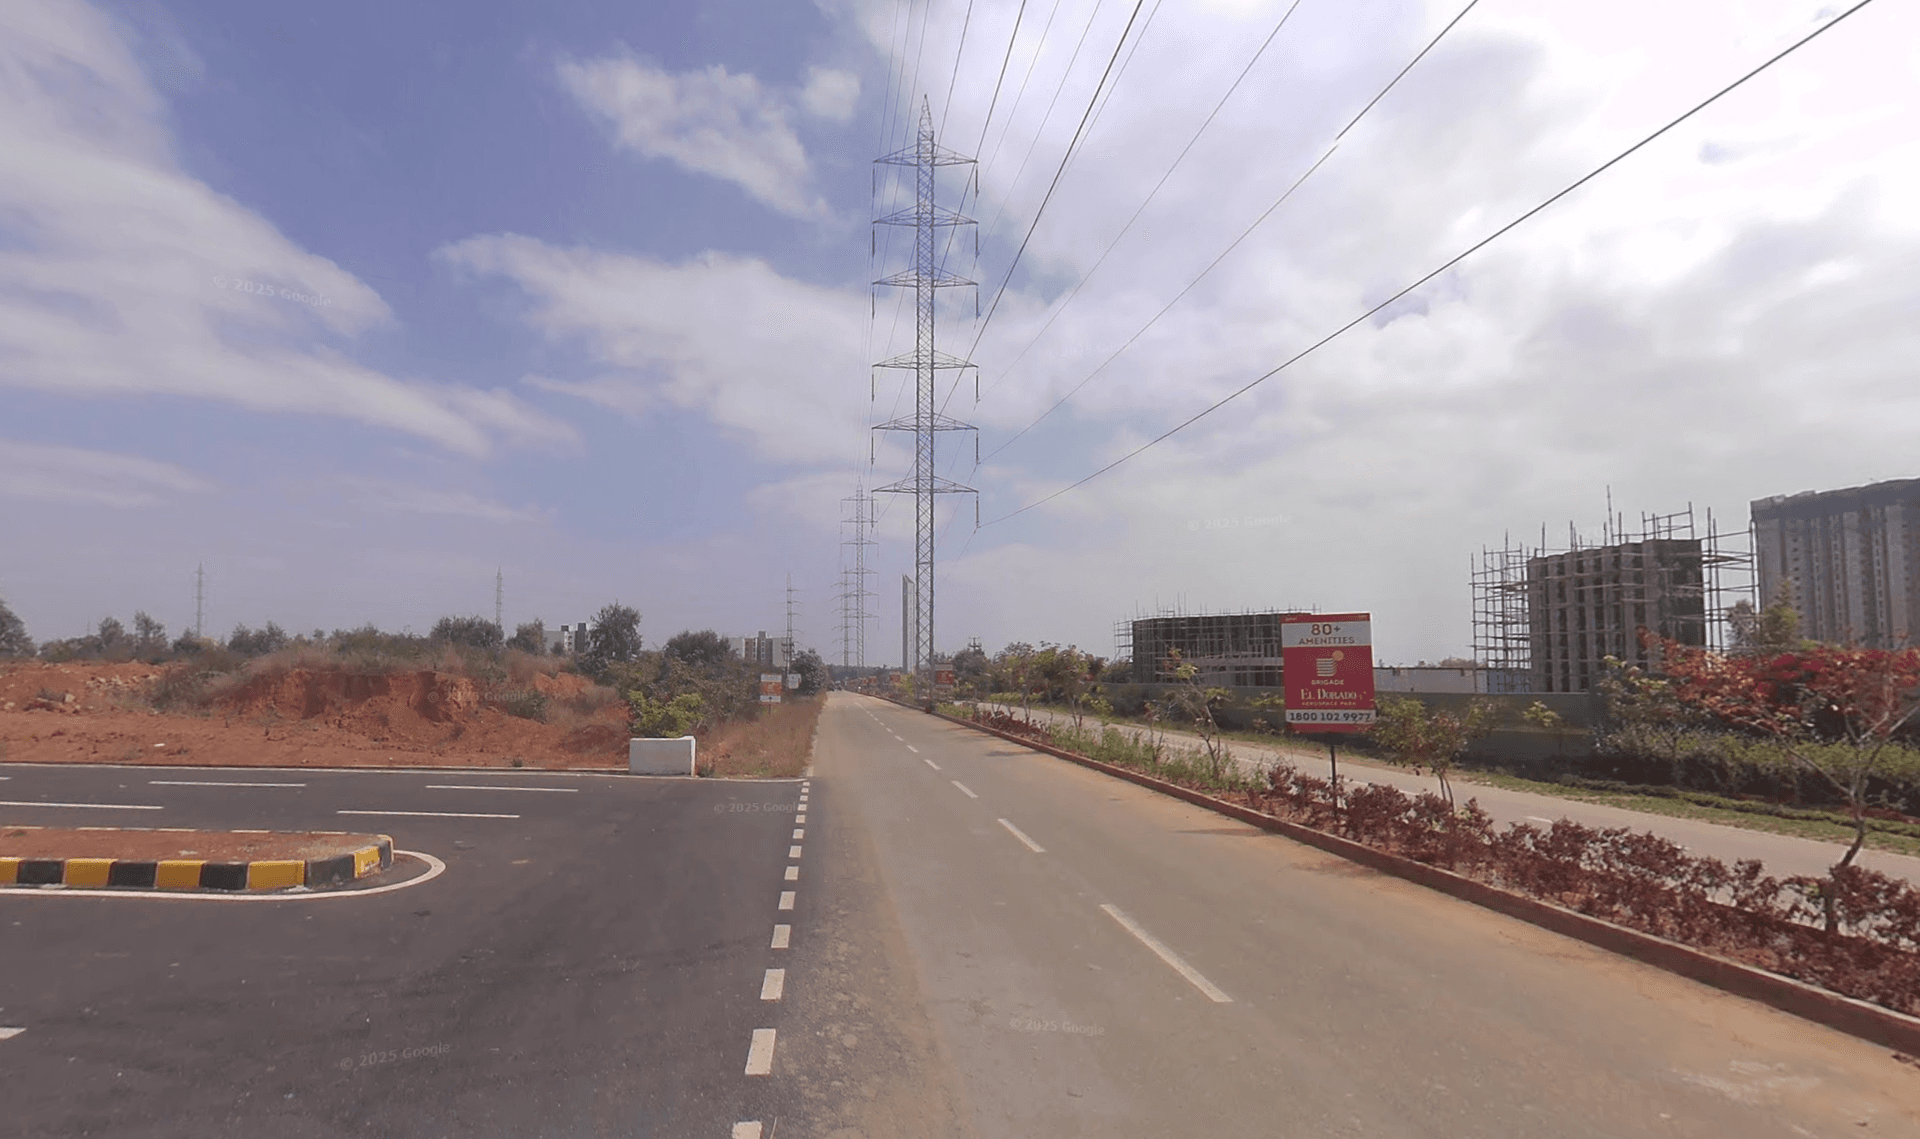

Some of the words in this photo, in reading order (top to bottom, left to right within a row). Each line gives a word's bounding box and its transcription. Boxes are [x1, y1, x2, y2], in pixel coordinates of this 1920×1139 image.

[1310, 623, 1341, 636] 80+
[1298, 636, 1355, 645] AMENITIES
[1290, 712, 1317, 721] 1800
[1320, 712, 1340, 721] 102
[1342, 712, 1371, 722] 9977
